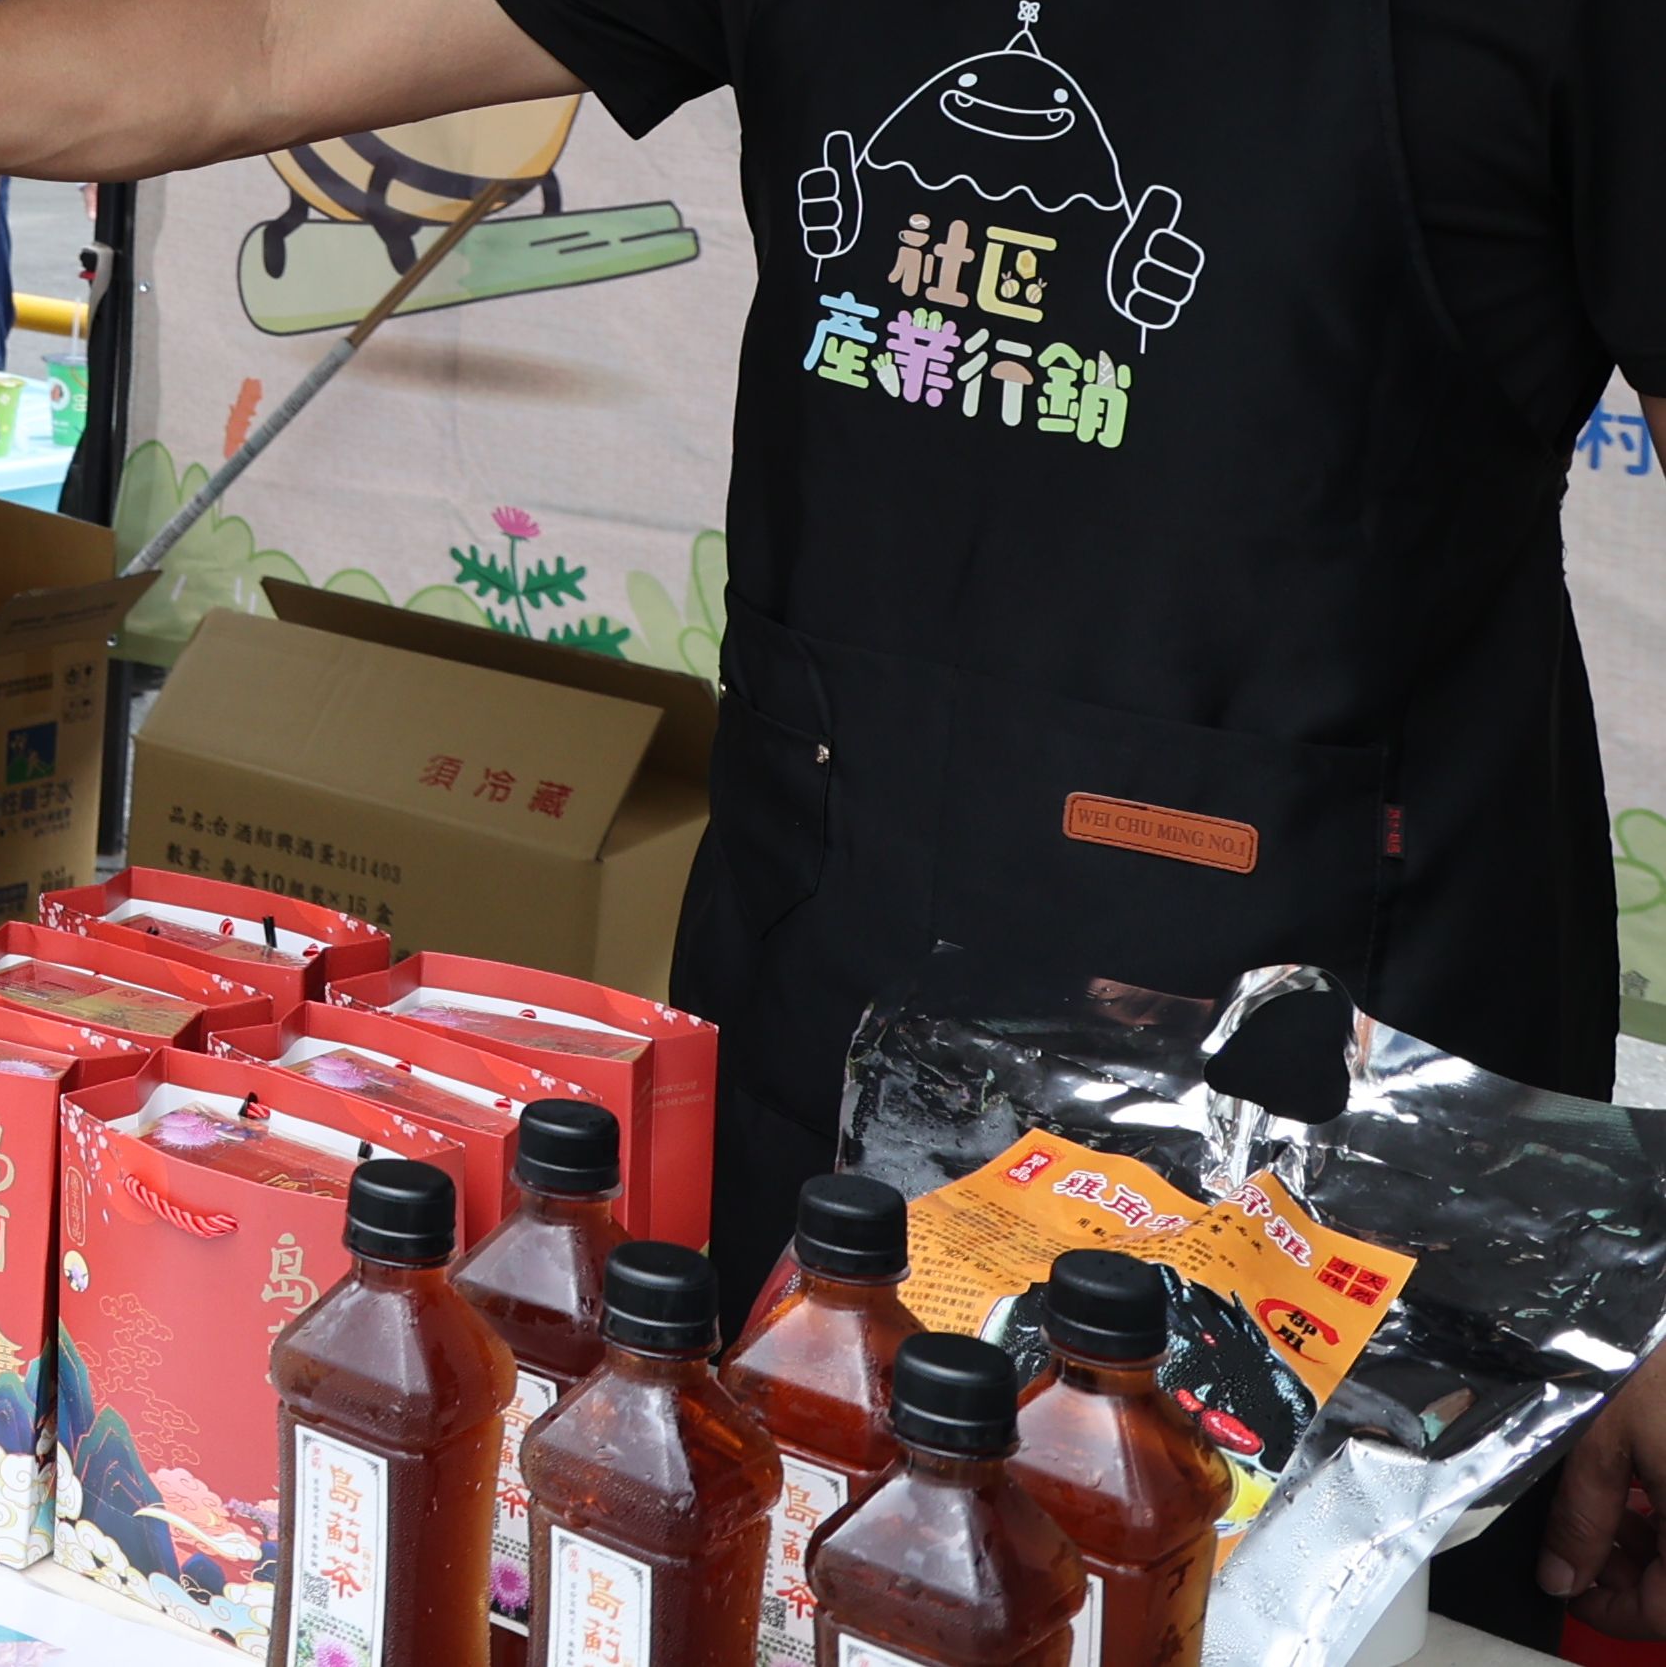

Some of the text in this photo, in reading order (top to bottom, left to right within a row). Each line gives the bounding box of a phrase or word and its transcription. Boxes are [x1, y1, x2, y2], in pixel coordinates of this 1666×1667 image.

[888, 213, 1058, 323] 社區
[803, 291, 1132, 449] 產業行銷
[1576, 399, 1652, 476] 村
[419, 755, 575, 821] 須冷藏
[1077, 807, 1246, 858] WEI CHU MING NO.1
[320, 1464, 363, 1600] 島薊茶
